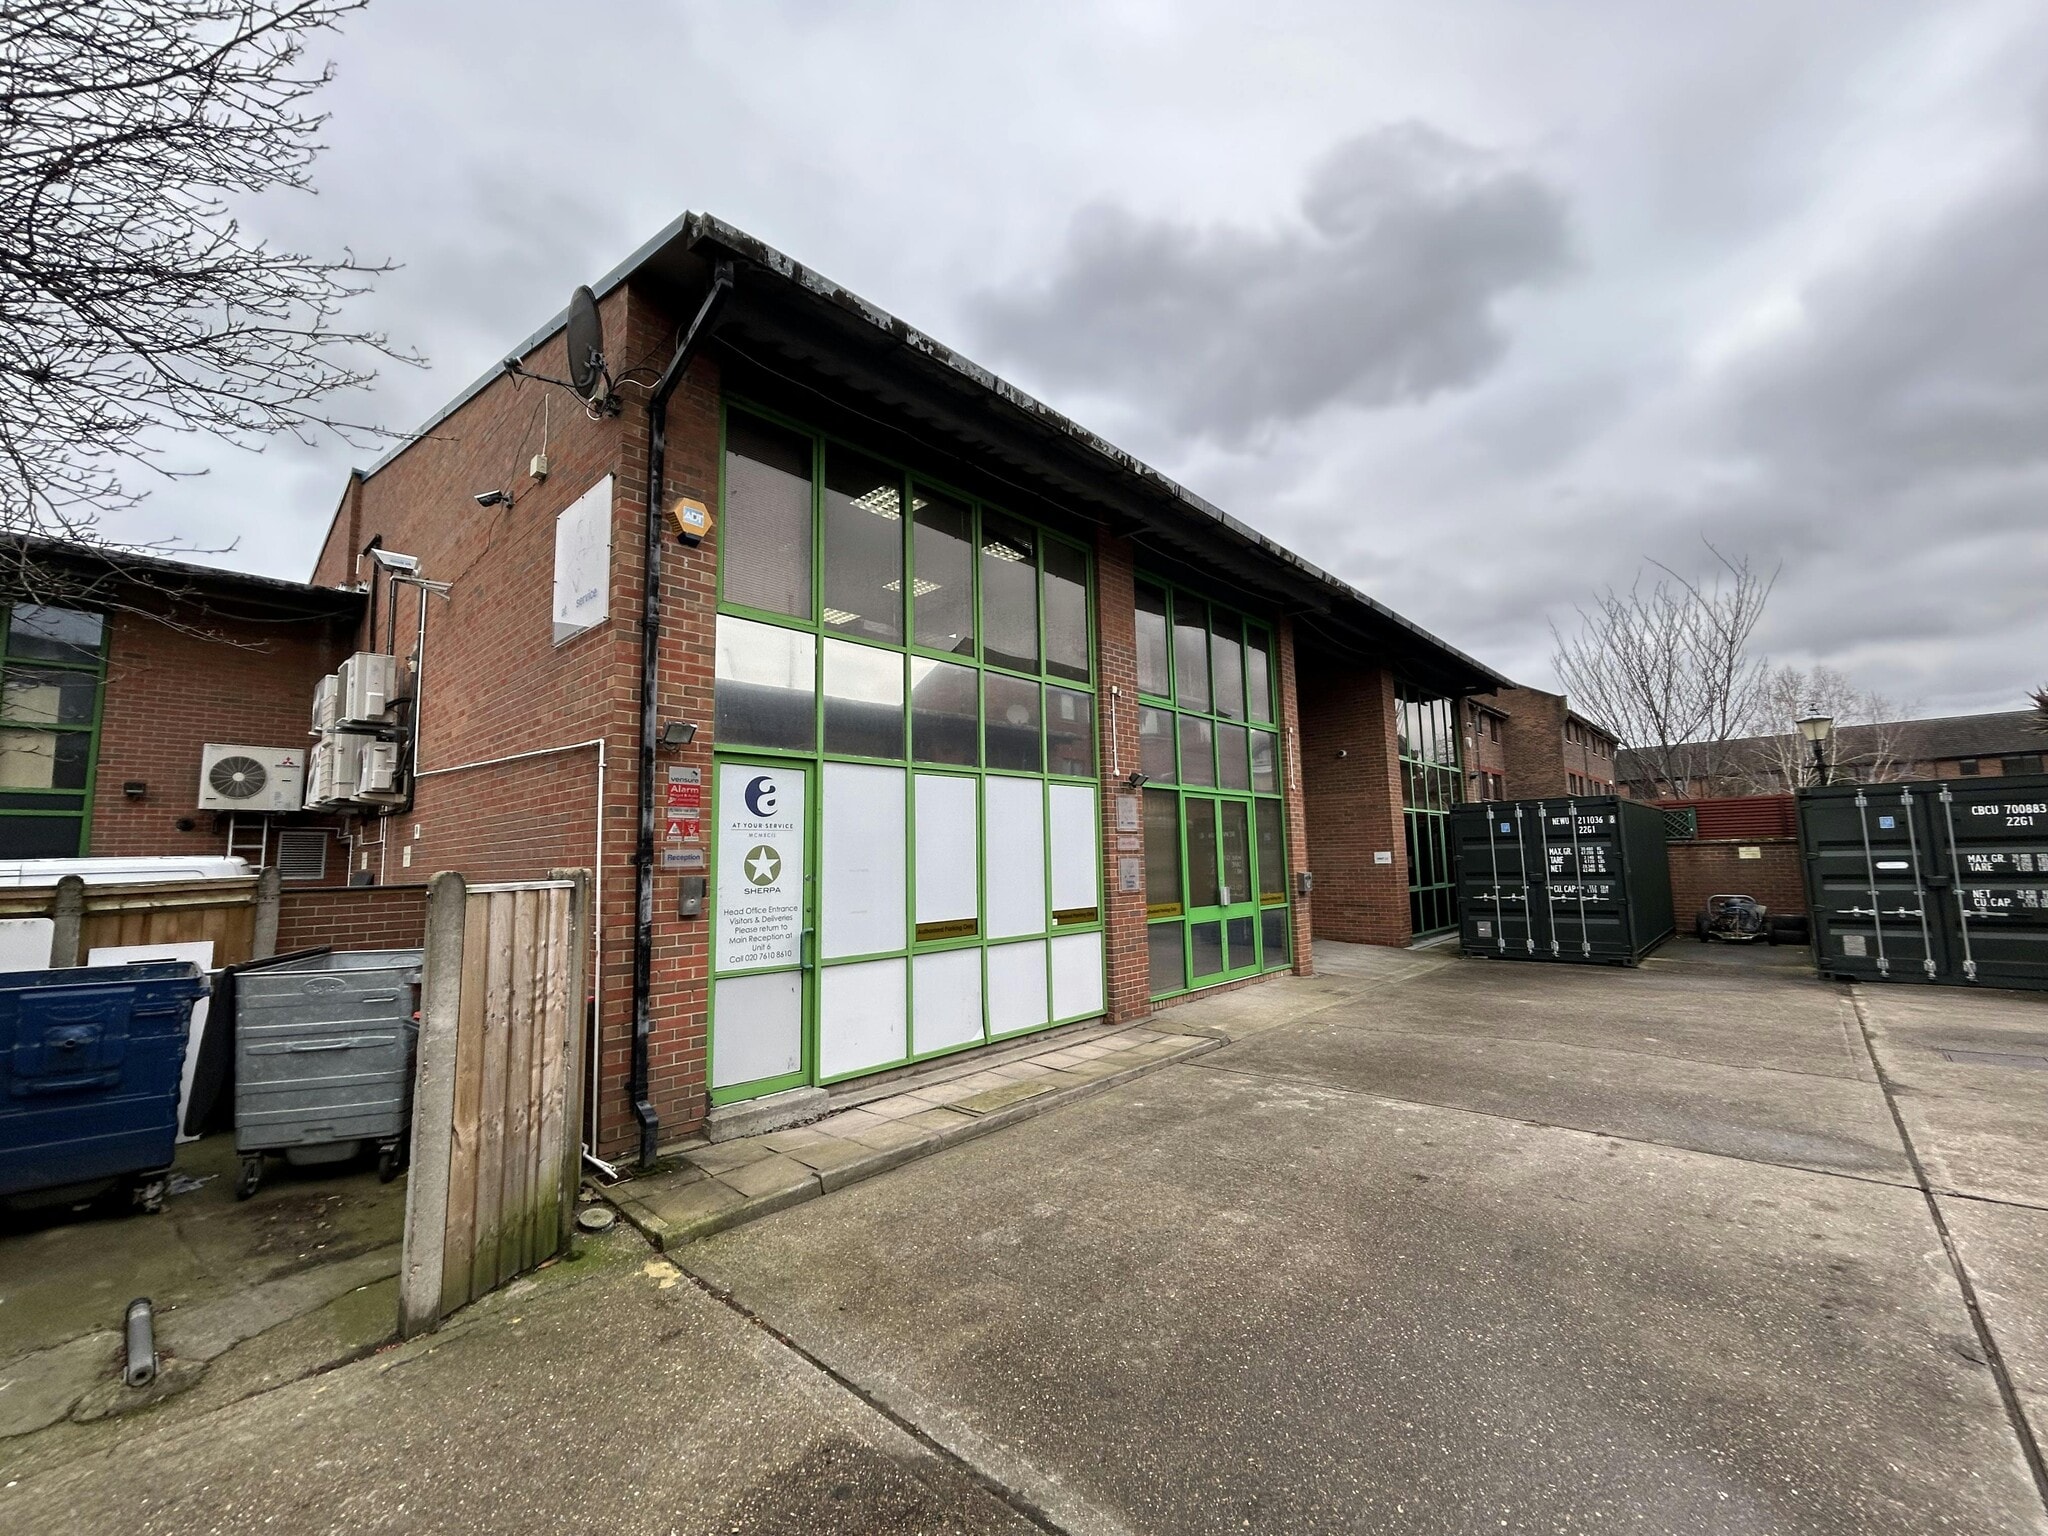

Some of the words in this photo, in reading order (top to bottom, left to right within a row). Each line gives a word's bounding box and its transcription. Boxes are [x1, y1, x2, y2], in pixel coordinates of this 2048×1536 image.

[684, 509, 704, 525] ADT
[670, 785, 699, 793] Alarm
[1971, 805, 1999, 815] CBCU
[2004, 803, 2047, 814] 700883
[1552, 817, 1570, 825] NEWU
[1577, 816, 1604, 824] 211036
[2006, 816, 2033, 826] 22G1
[1579, 826, 1596, 834] 22G1
[1550, 856, 1564, 864] TARE
[1969, 863, 1994, 871] TARE
[1972, 890, 1991, 898] NET
[762, 915, 793, 923] Deliveries
[734, 926, 758, 934] Please
[729, 936, 747, 944] Main
[748, 933, 784, 942] Reception
[729, 955, 744, 963] Call
[745, 953, 758, 961] 020
[759, 952, 775, 960] 7610
[776, 950, 792, 958] 8610
